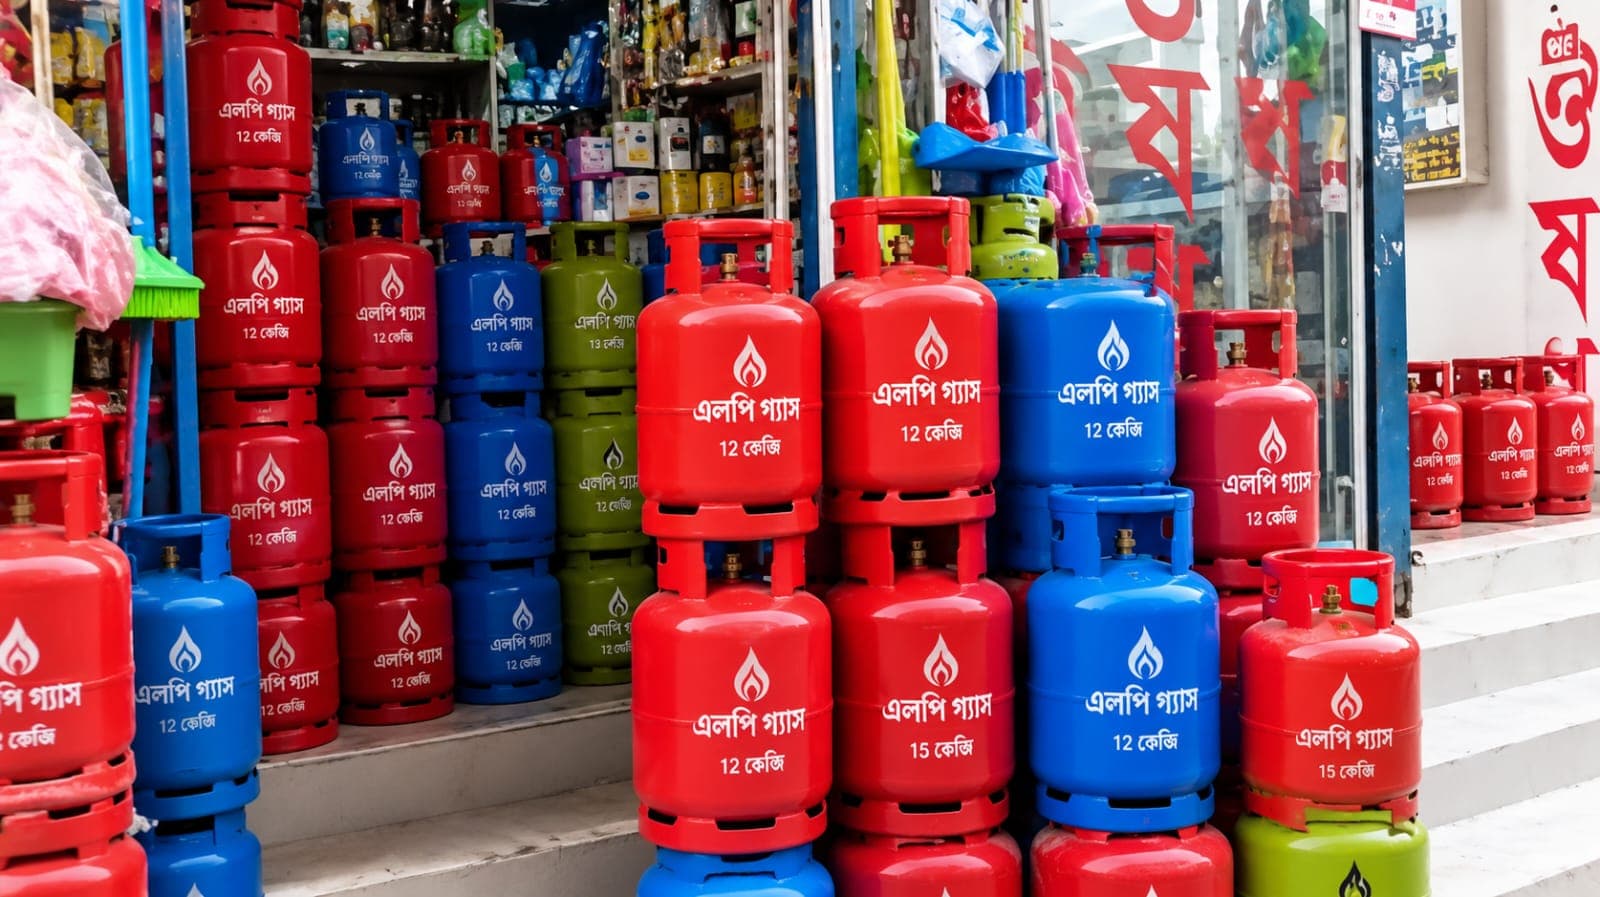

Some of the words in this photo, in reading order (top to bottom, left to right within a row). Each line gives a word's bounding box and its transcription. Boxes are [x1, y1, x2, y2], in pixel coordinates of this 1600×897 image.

[219, 98, 263, 118] এলপি
[267, 104, 295, 120] গ্যাস
[237, 131, 250, 142] 12
[254, 128, 281, 142] কেজি
[224, 293, 269, 314] এলপি
[273, 297, 304, 314] গ্যাস
[357, 302, 396, 321] এলপি
[400, 306, 425, 321] গ্যাস
[244, 328, 257, 338] 12
[261, 323, 289, 338] কেজি
[471, 313, 507, 331] এলপি
[374, 333, 386, 343] 12
[388, 329, 413, 343] কেজি
[487, 342, 498, 351] 12
[873, 375, 936, 406] এলপি
[942, 380, 981, 404] গ্যাস
[1058, 375, 1118, 404] এলপি
[1123, 381, 1160, 404] গ্যাস
[693, 392, 755, 422] এলপি
[760, 397, 800, 421] গ্যাস
[902, 426, 920, 441] 12
[925, 419, 963, 441] কেজি
[1085, 423, 1102, 438] 12
[1107, 417, 1142, 438] কেজি
[720, 440, 738, 456] 12
[743, 435, 781, 456] কেজি
[1488, 447, 1517, 461] এলপি
[1414, 450, 1442, 467] এলপি
[363, 481, 405, 501] এলপি
[409, 483, 435, 499] গ্যাস
[481, 479, 519, 497] এলপি
[523, 480, 546, 496] গ্যাস
[1222, 468, 1277, 494] এলপি
[1281, 472, 1311, 493] গ্যাস
[1427, 477, 1435, 485] 12
[230, 497, 275, 520] এলপি
[280, 499, 312, 517] গ্যাস
[381, 514, 393, 524] 12
[397, 509, 423, 524] কেজি
[498, 510, 509, 519] 12
[1247, 512, 1262, 525] 12
[1266, 505, 1297, 525] কেজি
[248, 533, 262, 545] 12
[266, 527, 296, 544] কেজি
[491, 633, 526, 651] এলপি
[601, 645, 612, 654] 12
[374, 648, 414, 667] এলপি
[417, 648, 442, 664] গ্যাস
[507, 660, 518, 670] 12
[289, 671, 319, 689] গ্যাস
[391, 678, 403, 688] 12
[29, 682, 82, 710] গ্যাস
[135, 676, 190, 705] এলপি
[196, 677, 234, 699] গ্যাস
[1086, 684, 1150, 715] এলপি
[1156, 688, 1198, 714] গ্যাস
[262, 706, 274, 716] 12
[277, 698, 305, 714] কেজি
[883, 691, 946, 722] এলপি
[952, 693, 992, 720] গ্যাস
[160, 719, 176, 733] 12
[181, 711, 216, 731] কেজি
[693, 707, 757, 737] এলপি
[762, 708, 805, 735] গ্যাস
[8, 724, 56, 749] কেজি
[911, 742, 929, 758] 15
[935, 735, 973, 758] কেজি
[1114, 735, 1132, 750] 12
[1138, 729, 1178, 751] কেজি
[1296, 724, 1351, 749] এলপি
[1356, 728, 1393, 749] গ্যাস
[721, 758, 739, 774] 12
[745, 750, 785, 773] কেজি
[1319, 765, 1335, 778] 15
[1340, 760, 1375, 778] কেজি
